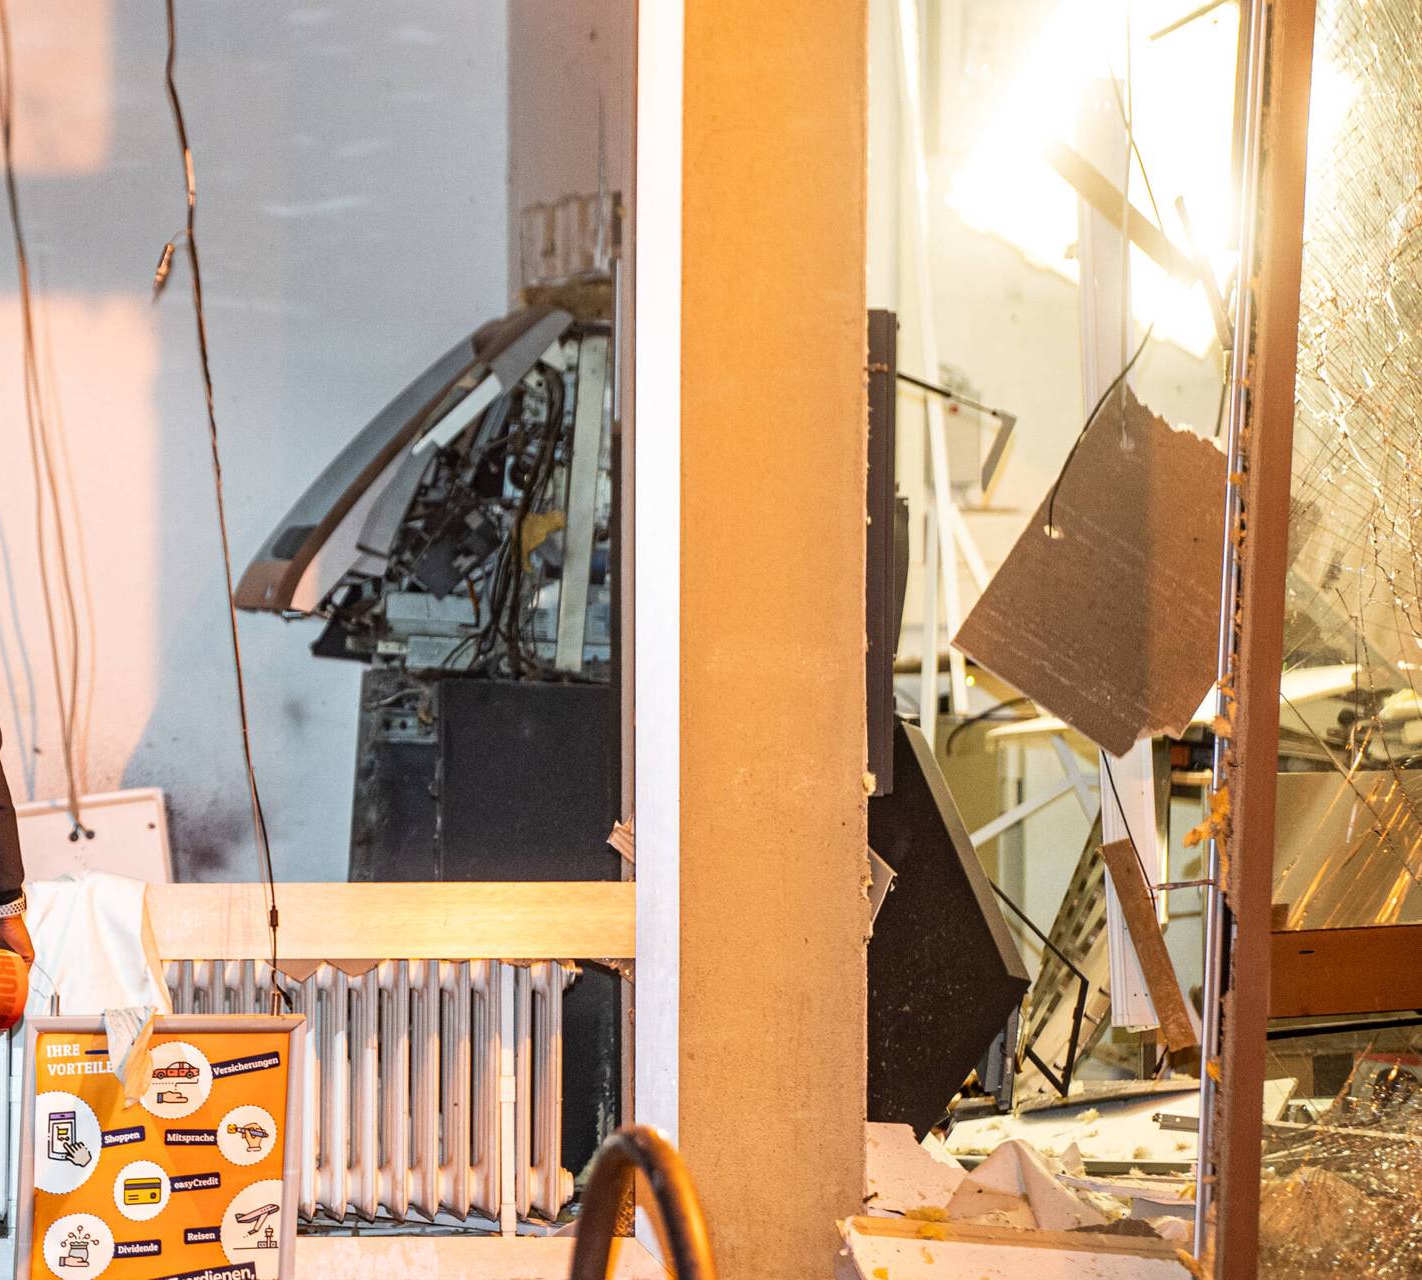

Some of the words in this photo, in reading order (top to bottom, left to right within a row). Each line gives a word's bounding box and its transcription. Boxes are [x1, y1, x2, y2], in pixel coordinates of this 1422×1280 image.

[46, 1044, 80, 1058] IHRE
[47, 1061, 114, 1076] VORTEILE
[213, 1056, 279, 1076] Versicherungen
[104, 1131, 140, 1144] Shoppen
[166, 1132, 215, 1144] Mitsprache
[173, 1176, 219, 1190] easyCredit
[187, 1231, 216, 1242] Reisen
[118, 1242, 159, 1255] Dividende
